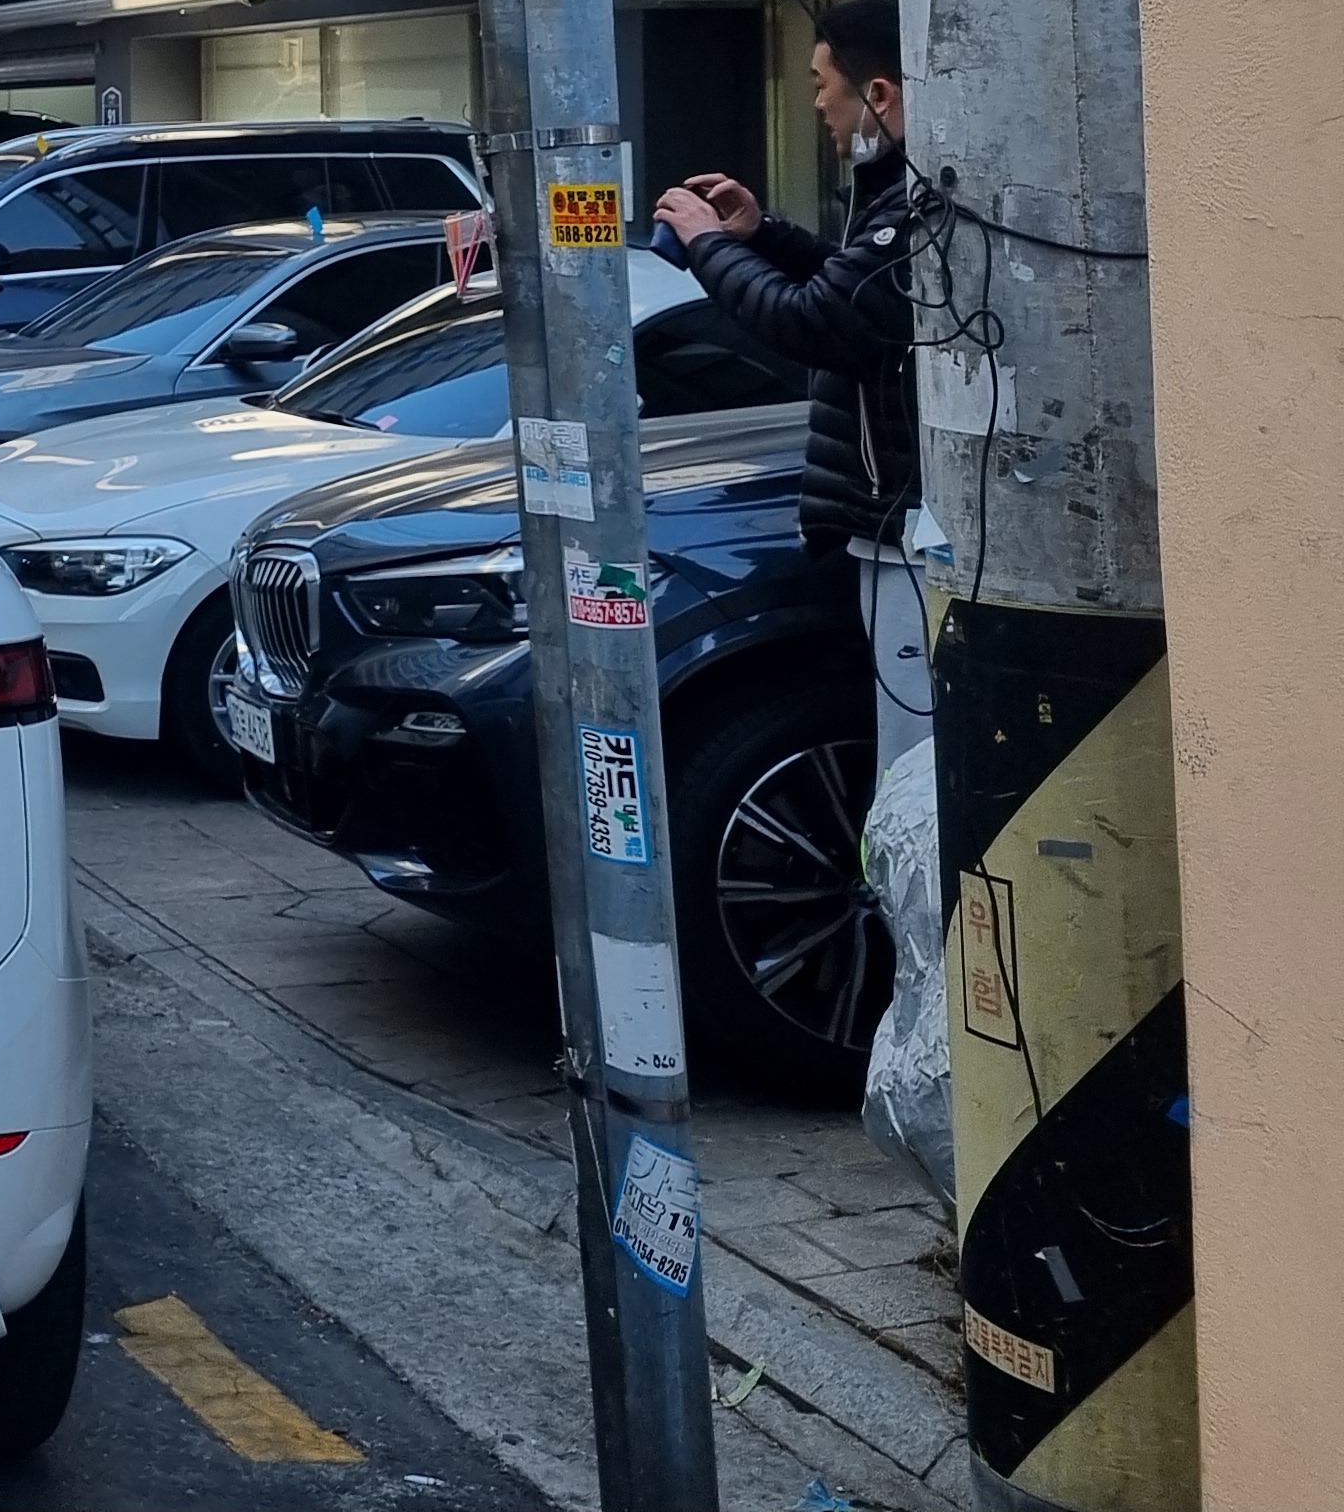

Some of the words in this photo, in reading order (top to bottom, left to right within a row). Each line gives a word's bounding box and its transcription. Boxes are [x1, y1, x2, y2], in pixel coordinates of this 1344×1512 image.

[555, 225, 618, 243] 1588-8221
[569, 567, 593, 586] 카드
[604, 735, 637, 799] 카드
[582, 731, 612, 856] 010-7359-4353
[668, 1212, 696, 1239] 1%
[614, 1217, 689, 1285] 010-2154-8285
